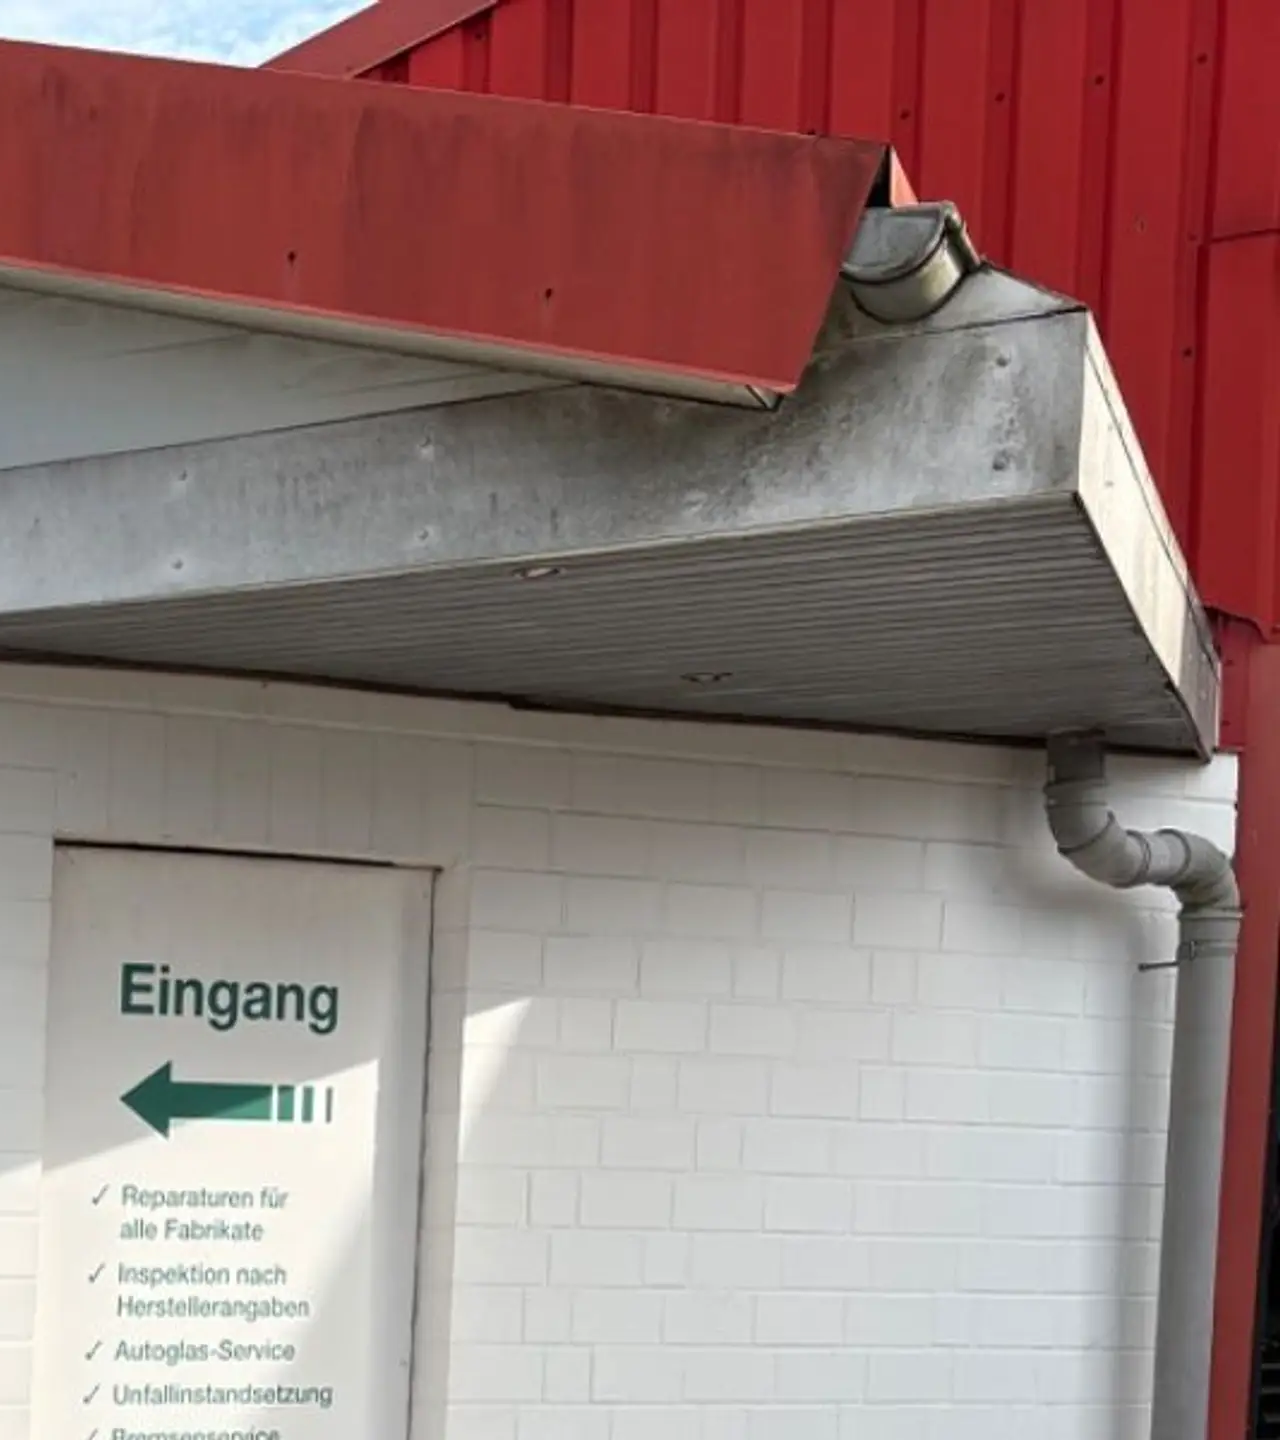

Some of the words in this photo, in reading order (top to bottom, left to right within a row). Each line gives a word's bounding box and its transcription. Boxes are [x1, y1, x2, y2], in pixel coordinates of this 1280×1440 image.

[120, 962, 339, 1035] Eingang
[121, 1184, 254, 1211] Reparaturen
[260, 1186, 288, 1209] für
[120, 1219, 157, 1241] alle
[164, 1219, 265, 1242] Fabrikate
[117, 1262, 229, 1287] Inspektion
[236, 1264, 287, 1285] nach
[116, 1296, 310, 1321] Herstellerangaben
[114, 1339, 295, 1366] Autoglas-Service
[113, 1384, 333, 1408] Unfallinstandsetzung
